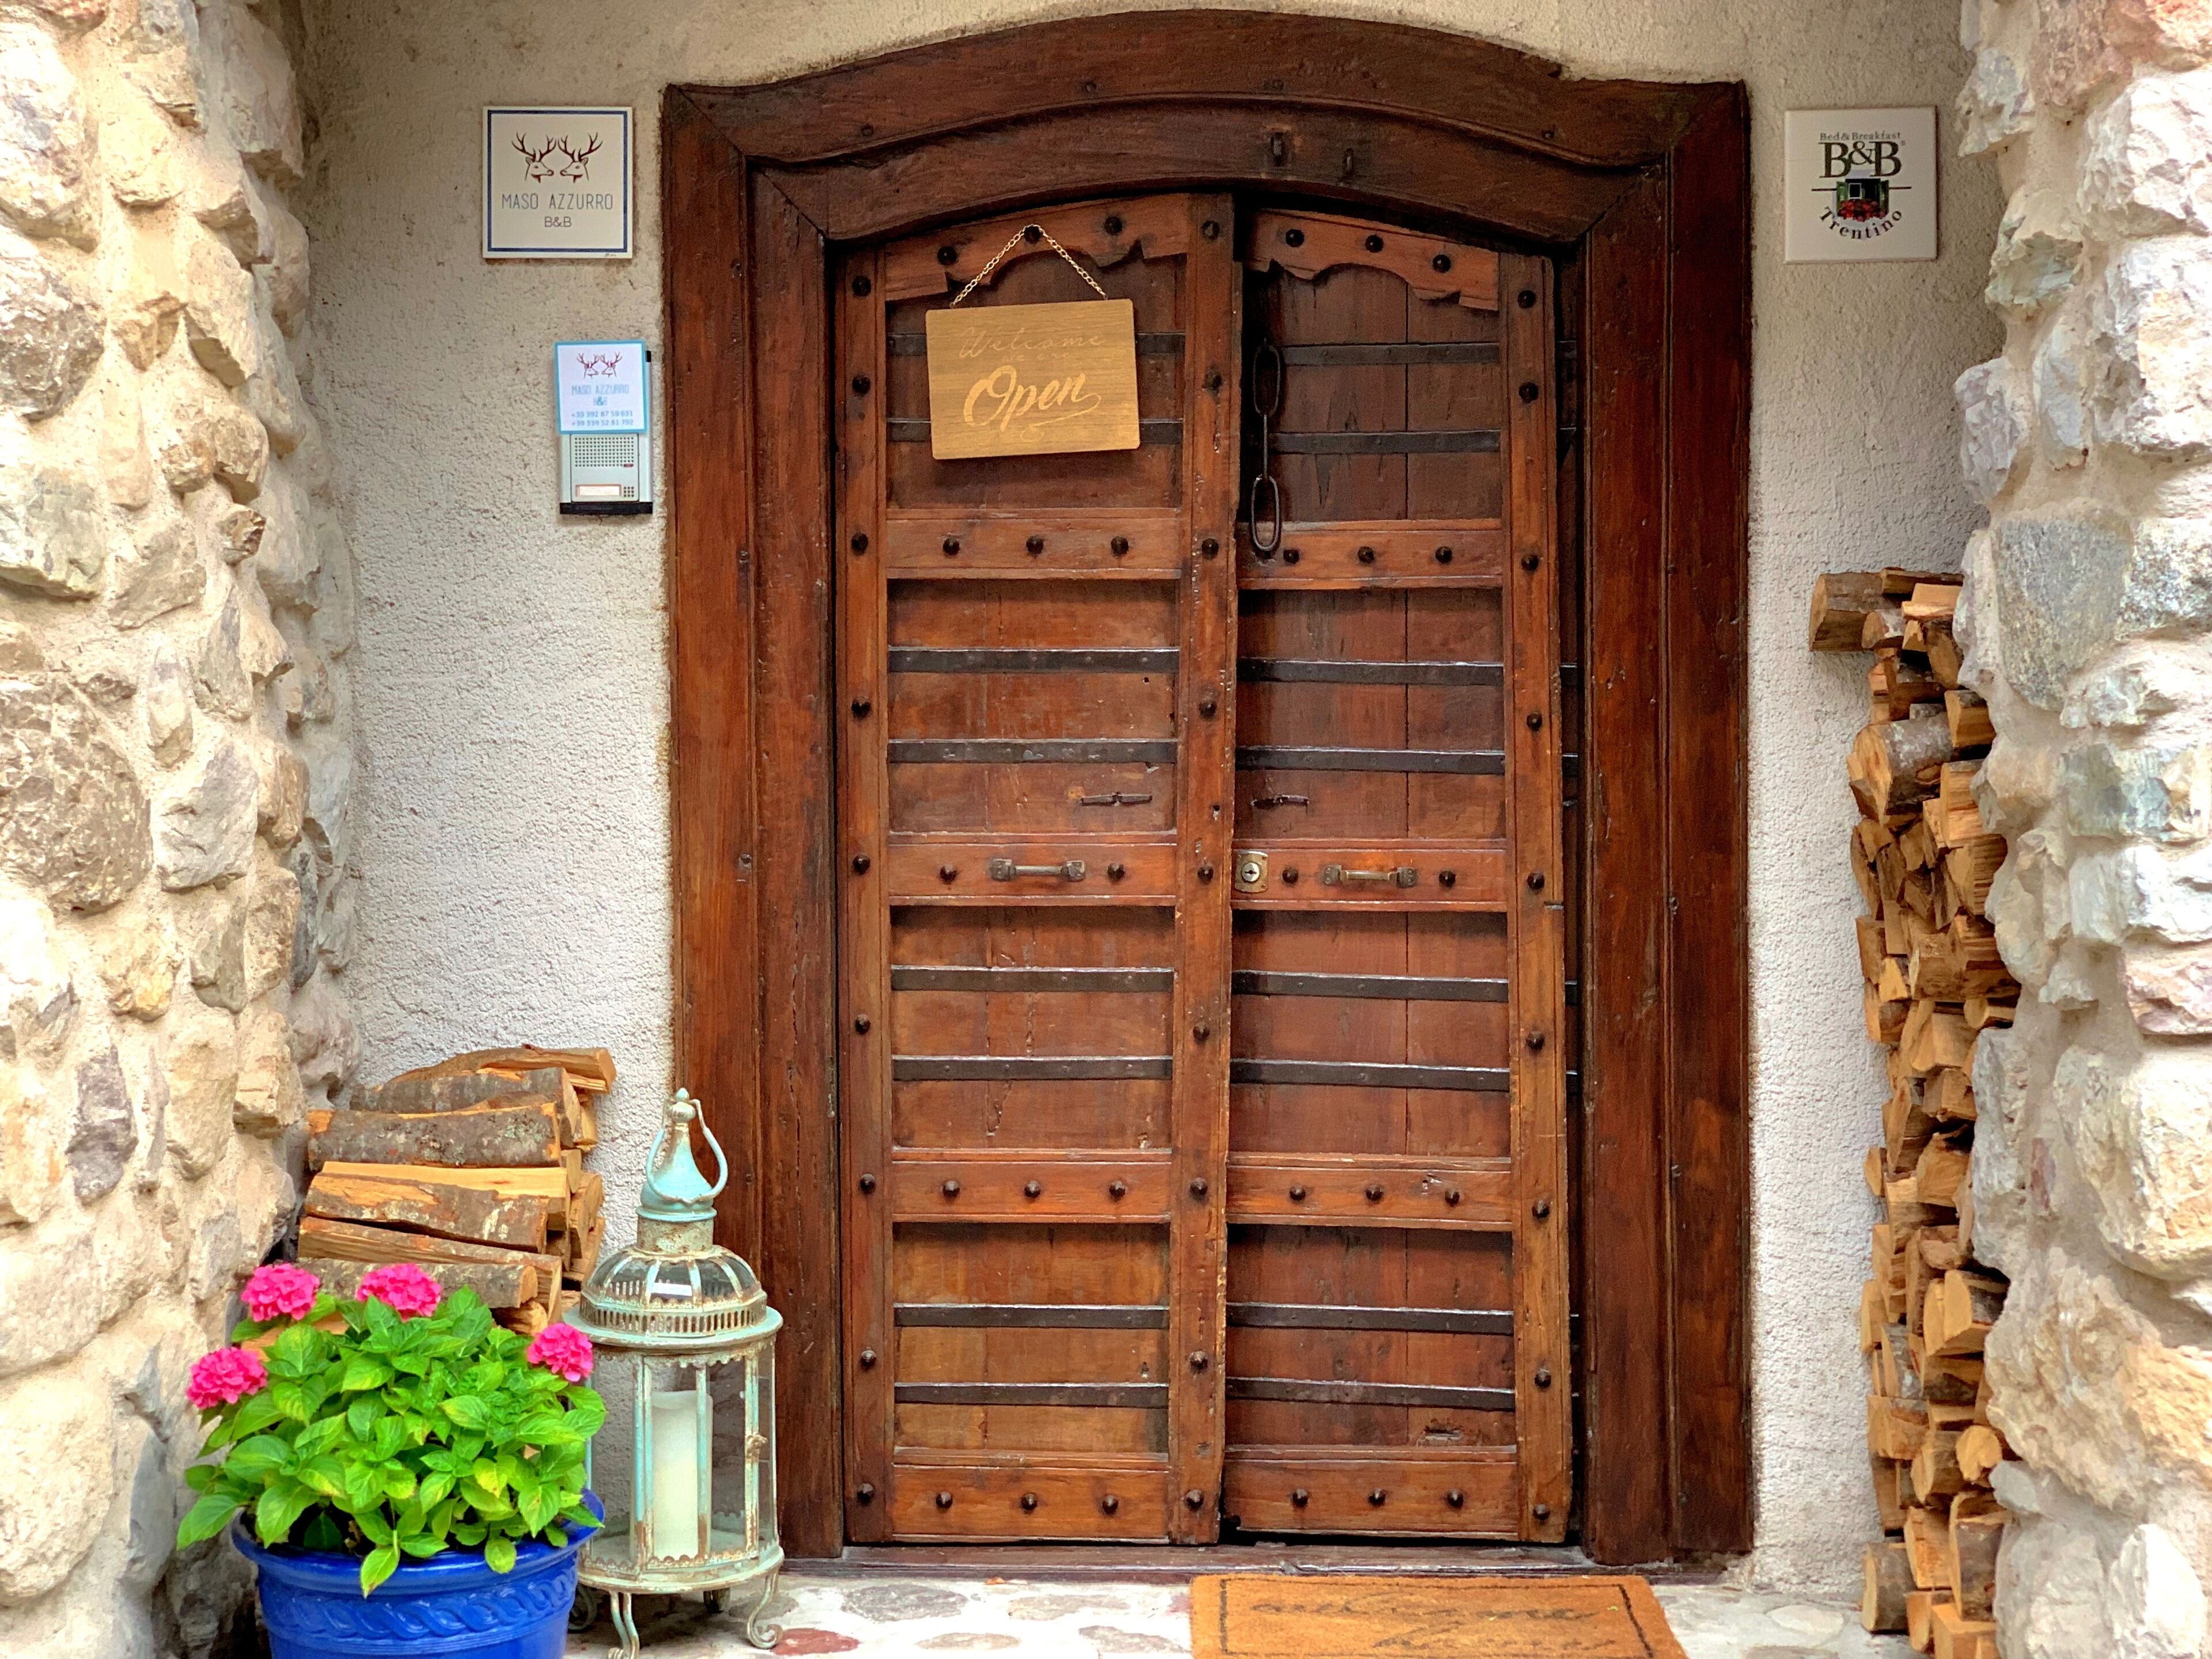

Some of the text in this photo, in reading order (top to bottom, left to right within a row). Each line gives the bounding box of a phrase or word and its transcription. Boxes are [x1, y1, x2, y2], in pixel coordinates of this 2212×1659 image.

[1819, 141, 1902, 178] B&B
[501, 193, 613, 210] MASO AZZURRO
[544, 216, 573, 228] B&B
[1819, 206, 1902, 240] Trentino
[957, 326, 1106, 358] Welcome
[963, 364, 1101, 433] Open
